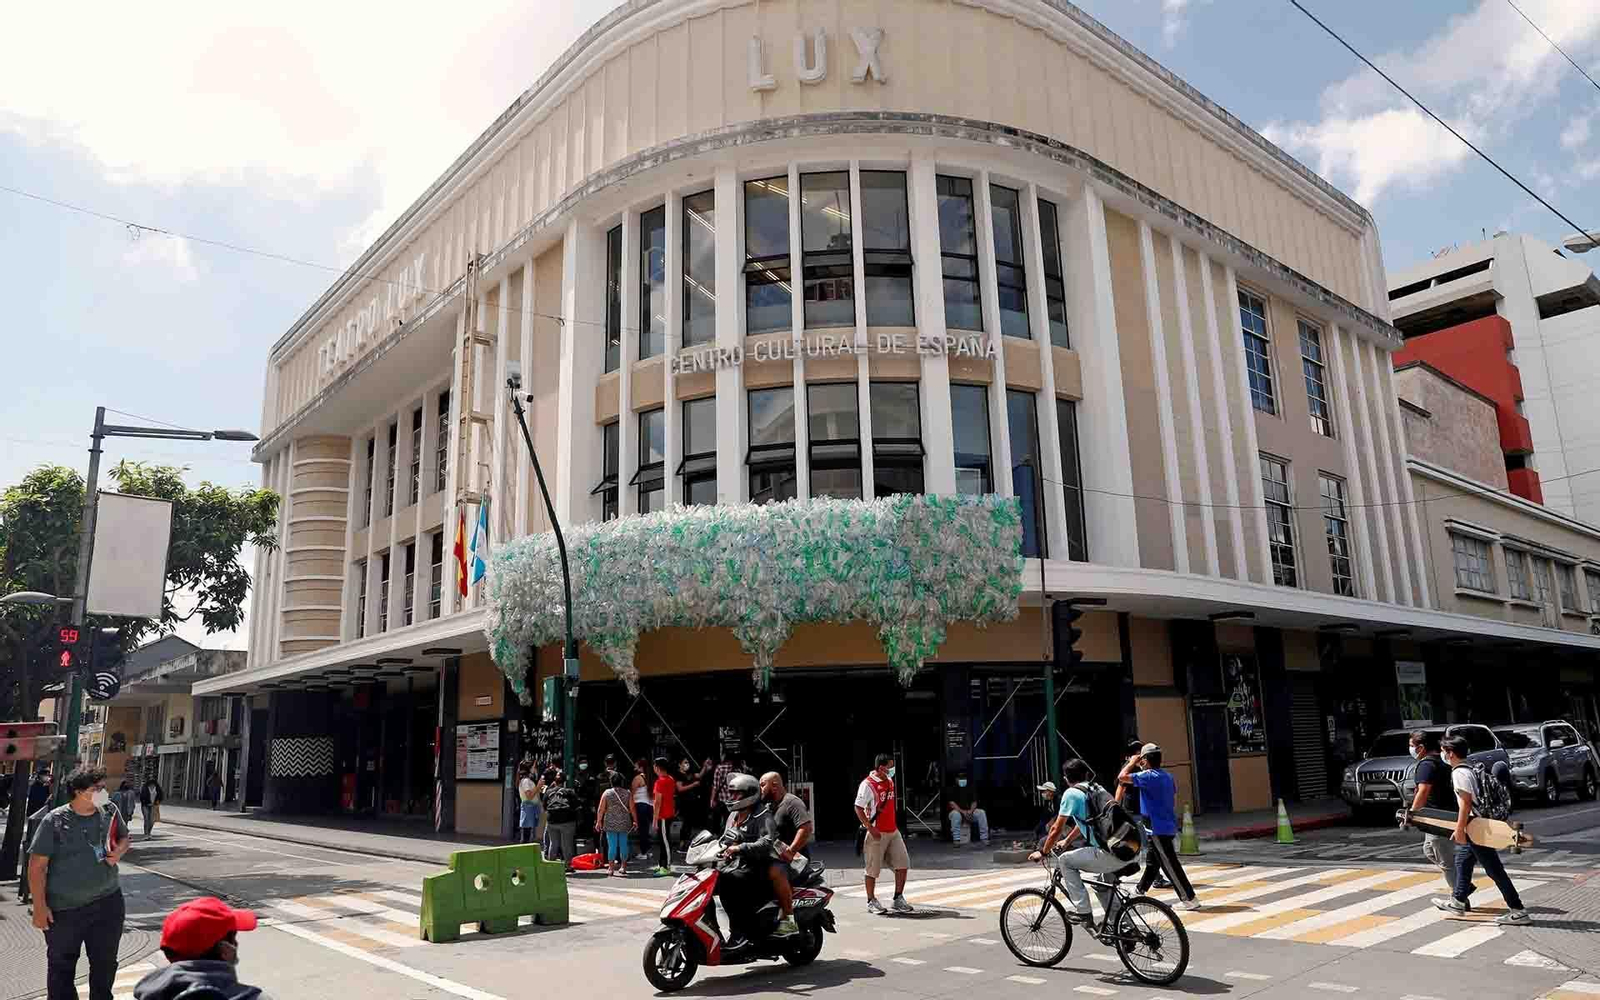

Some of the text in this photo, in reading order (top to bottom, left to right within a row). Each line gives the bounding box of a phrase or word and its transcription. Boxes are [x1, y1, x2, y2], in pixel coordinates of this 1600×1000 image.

[747, 26, 887, 92] LUX
[318, 252, 427, 377] TEATRO LUX
[671, 333, 998, 375] CENTRO CULTURAL DE ESPAÑA
[60, 629, 79, 643] 59
